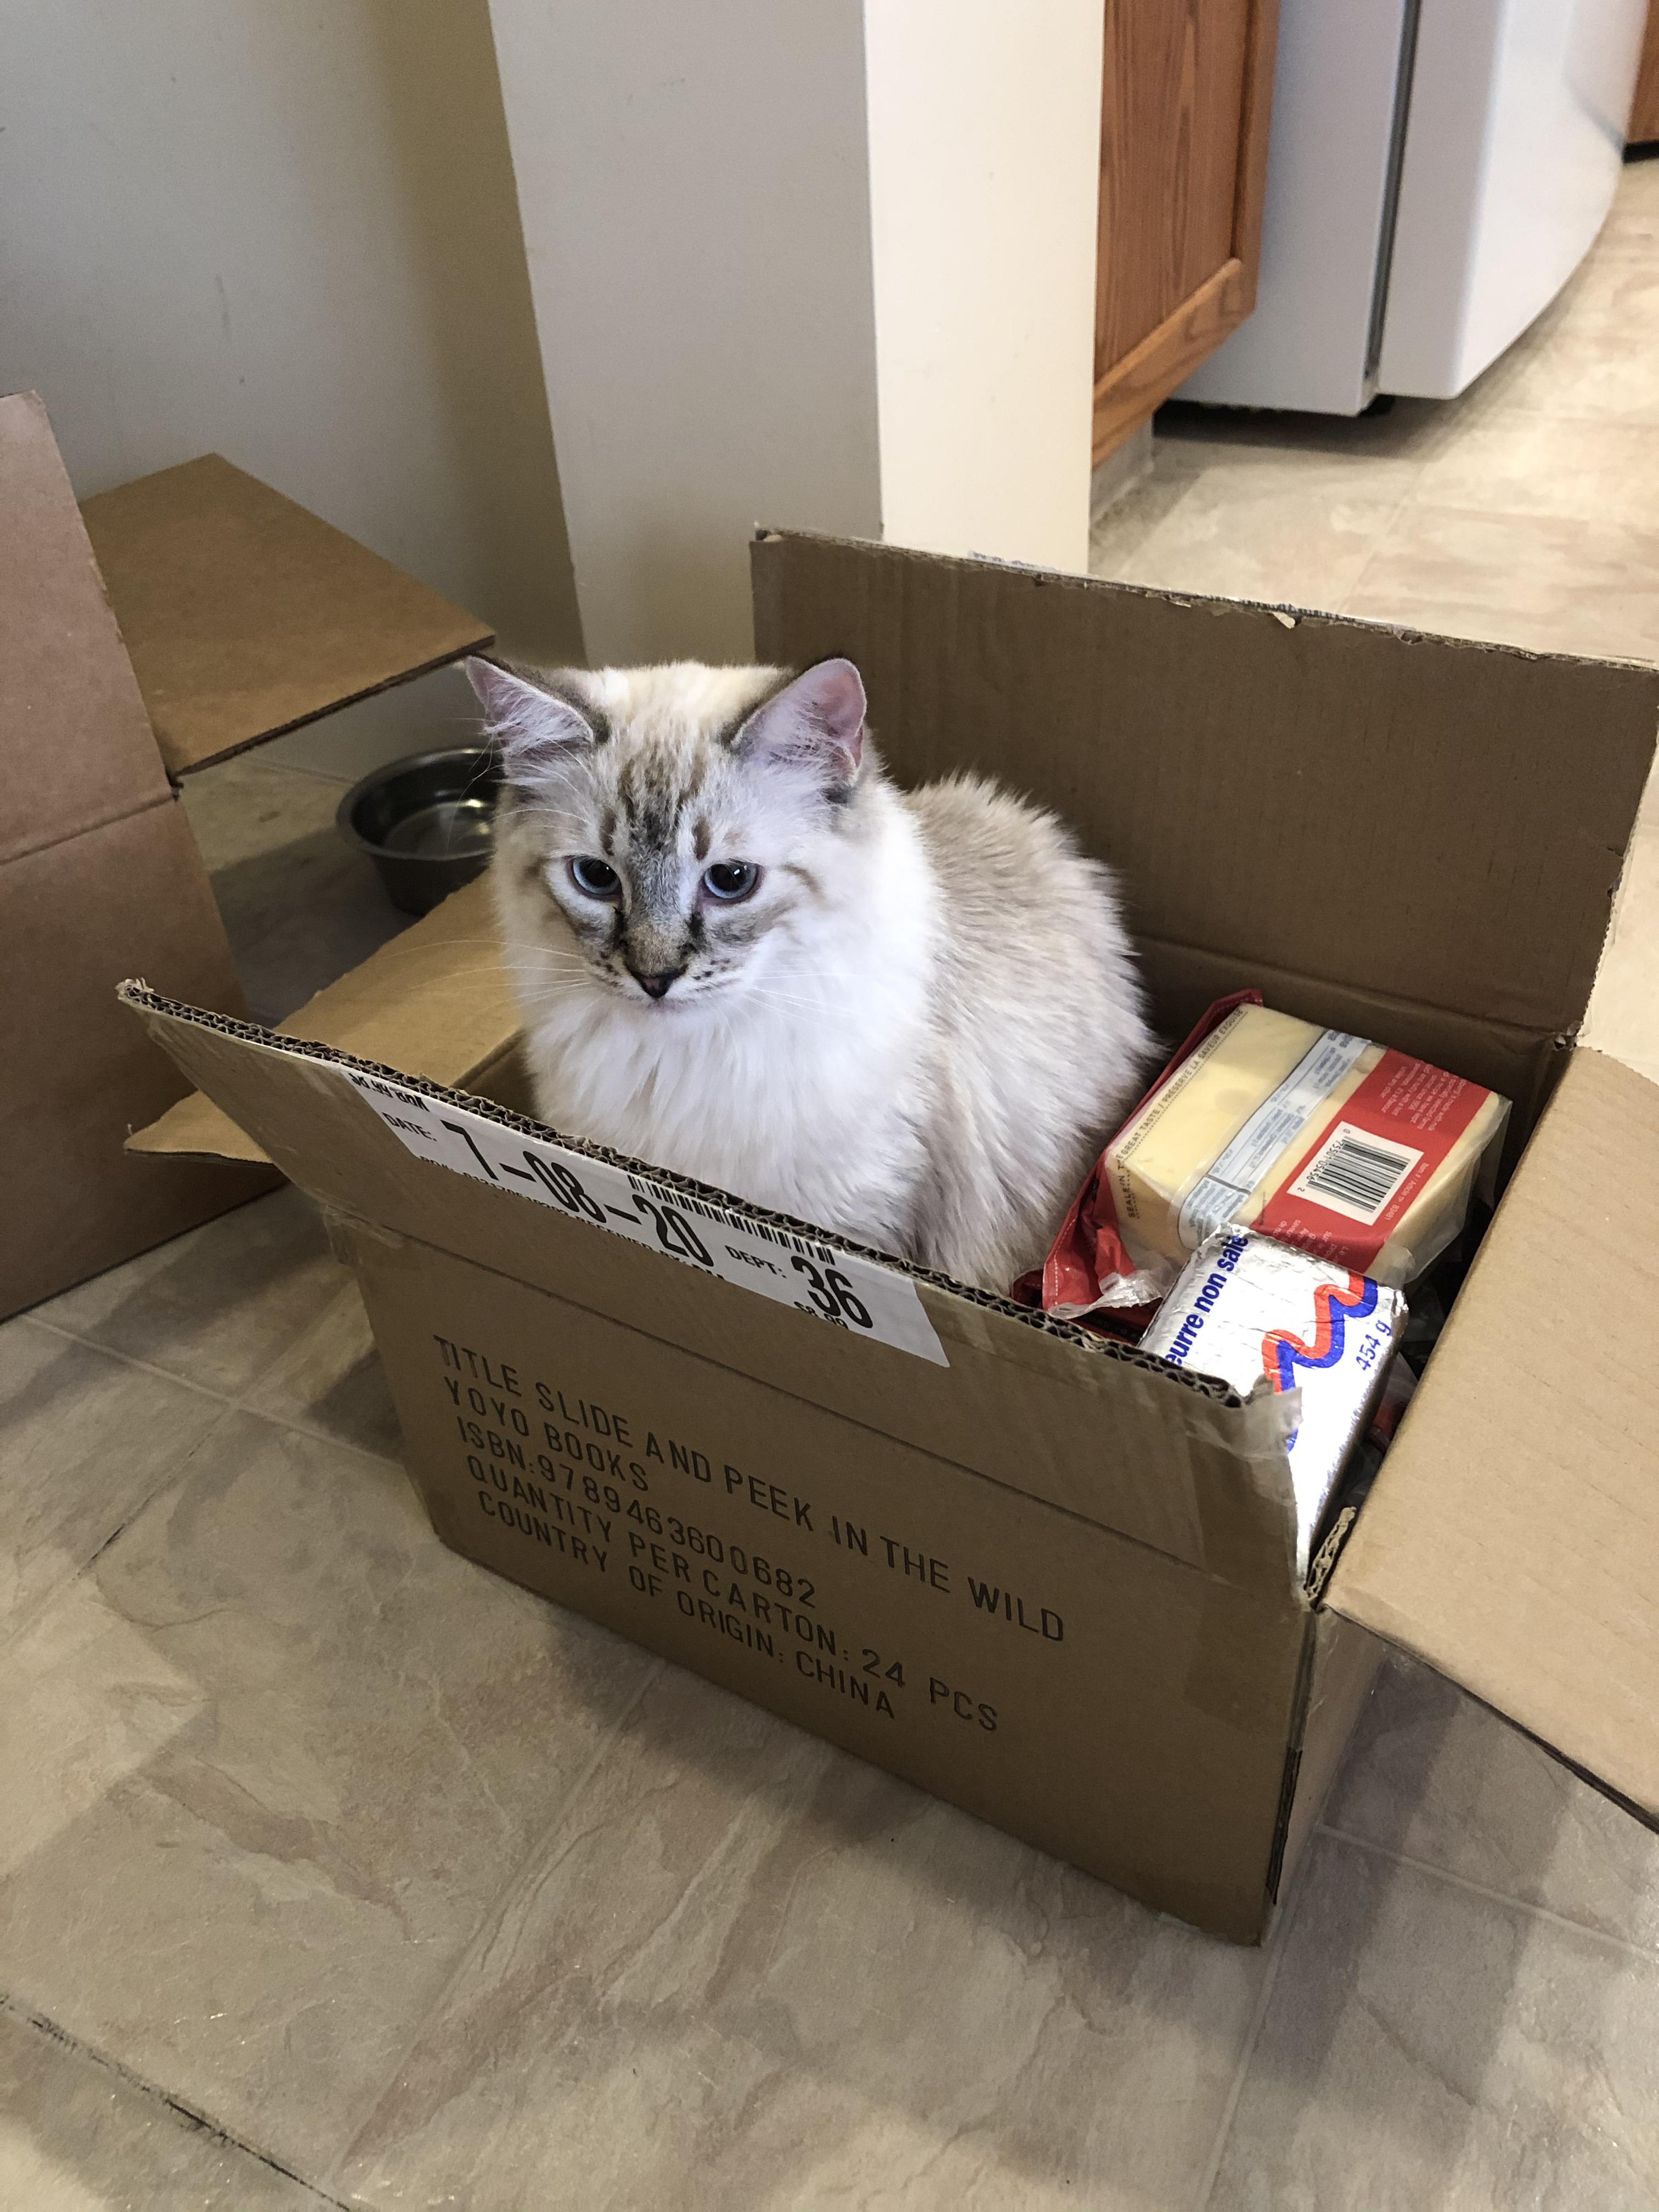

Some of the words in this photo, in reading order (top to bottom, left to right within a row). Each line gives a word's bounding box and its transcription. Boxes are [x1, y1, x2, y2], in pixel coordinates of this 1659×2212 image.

[1190, 1060, 1199, 1070] LA
[1198, 1034, 1221, 1059] SAVEUR
[1121, 1132, 1141, 1155] GREAT
[1139, 1109, 1160, 1130] TASTE
[382, 1111, 437, 1142] DATE:
[725, 1245, 787, 1278] DEPT:
[791, 1255, 873, 1329] 36
[1122, 1188, 1135, 1218] SEALS
[793, 1301, 849, 1329] $899
[1165, 1313, 1204, 1366] eurre
[1194, 1273, 1228, 1313] non
[1355, 1334, 1381, 1371] 454
[1375, 1319, 1392, 1336] g
[444, 1375, 529, 1437] YOYO
[544, 1422, 649, 1492] BOOKS
[433, 1334, 522, 1397] TITLE
[535, 1381, 634, 1448] SLIDE
[646, 1432, 712, 1482] AND
[724, 1465, 814, 1531] PEEK
[832, 1515, 868, 1556] IN
[879, 1536, 950, 1593] THE
[967, 1576, 1064, 1642] WILD
[467, 1455, 612, 1543] QUANTITY
[628, 1532, 691, 1583] PER
[703, 1569, 849, 1661] CARTON:
[862, 1648, 906, 1688] 24
[929, 1677, 998, 1731] PCS
[478, 1490, 608, 1572] COUNTRY
[629, 1565, 663, 1597] OF
[676, 1590, 785, 1663] ORIGIN:
[796, 1650, 895, 1719] CHINA
